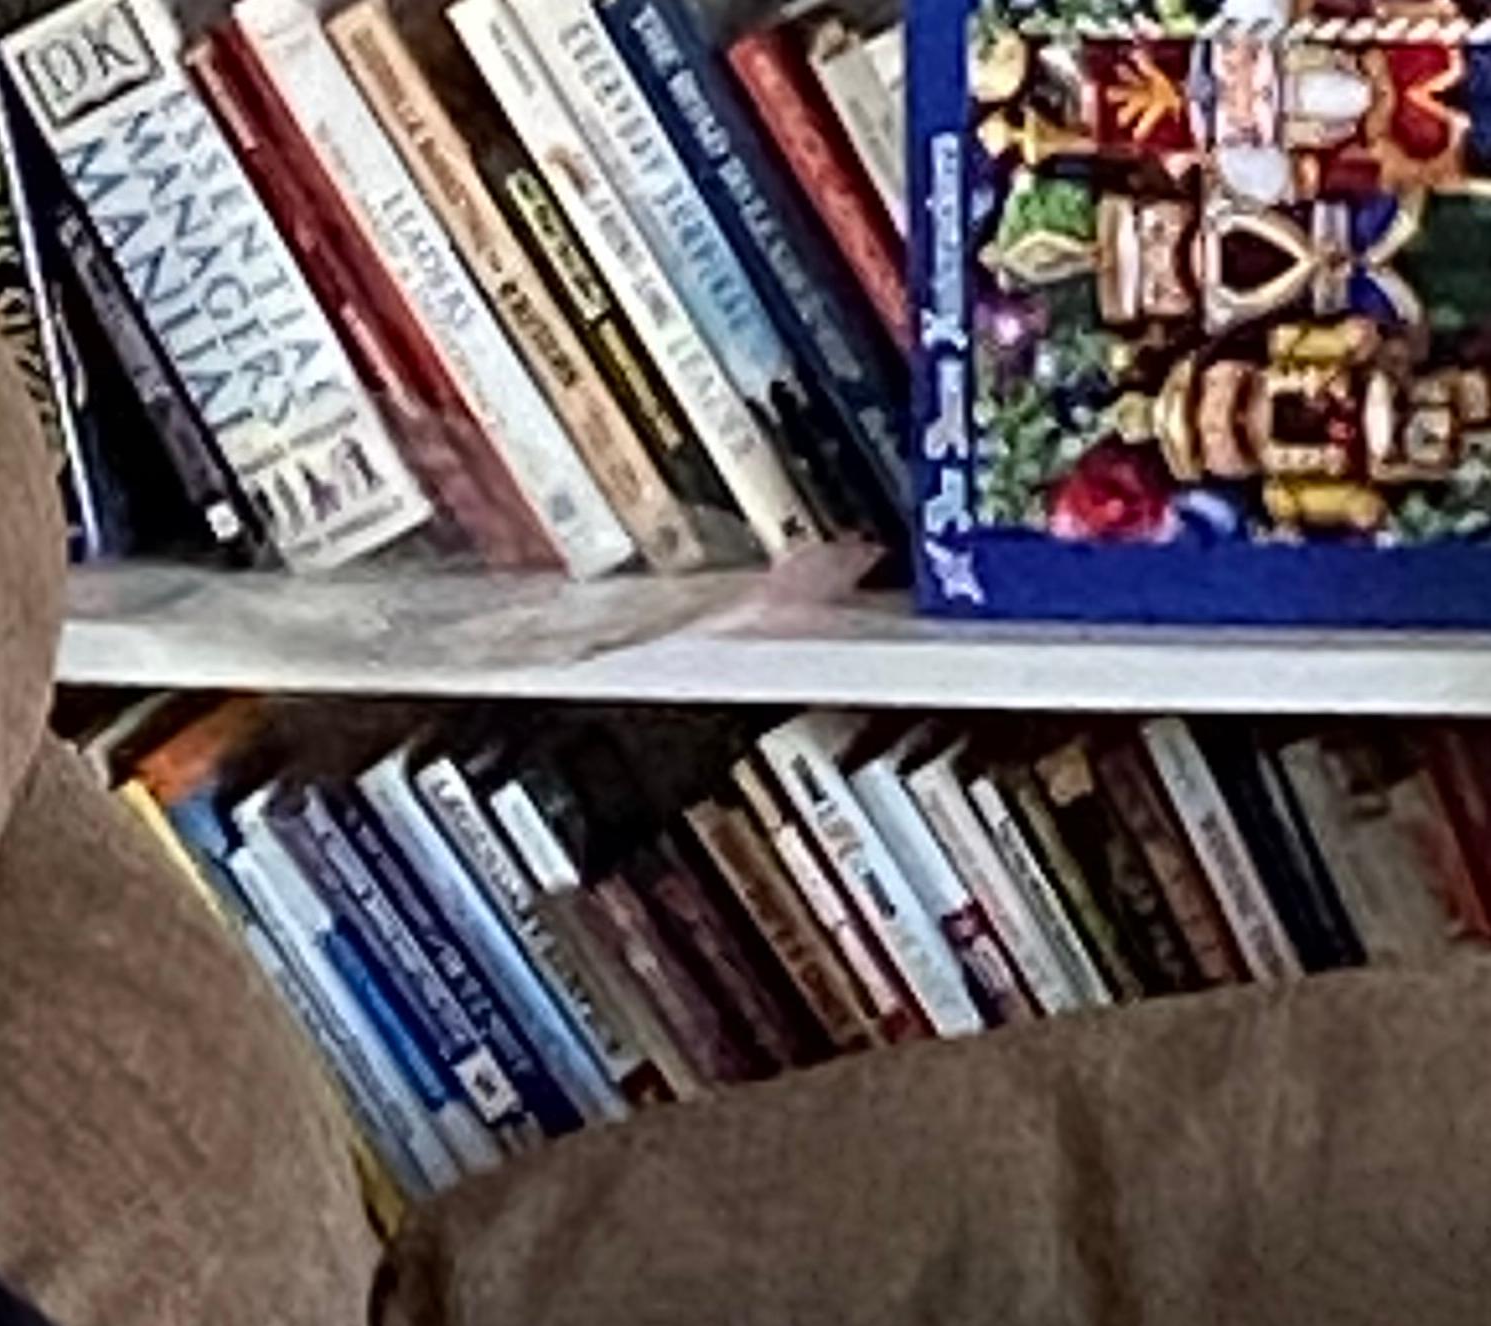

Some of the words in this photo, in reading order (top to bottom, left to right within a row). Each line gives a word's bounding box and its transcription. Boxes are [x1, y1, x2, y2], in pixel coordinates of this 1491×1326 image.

[38, 11, 136, 100] DK
[58, 137, 254, 430] MANUAL
[158, 91, 351, 402] ESSENTIAL
